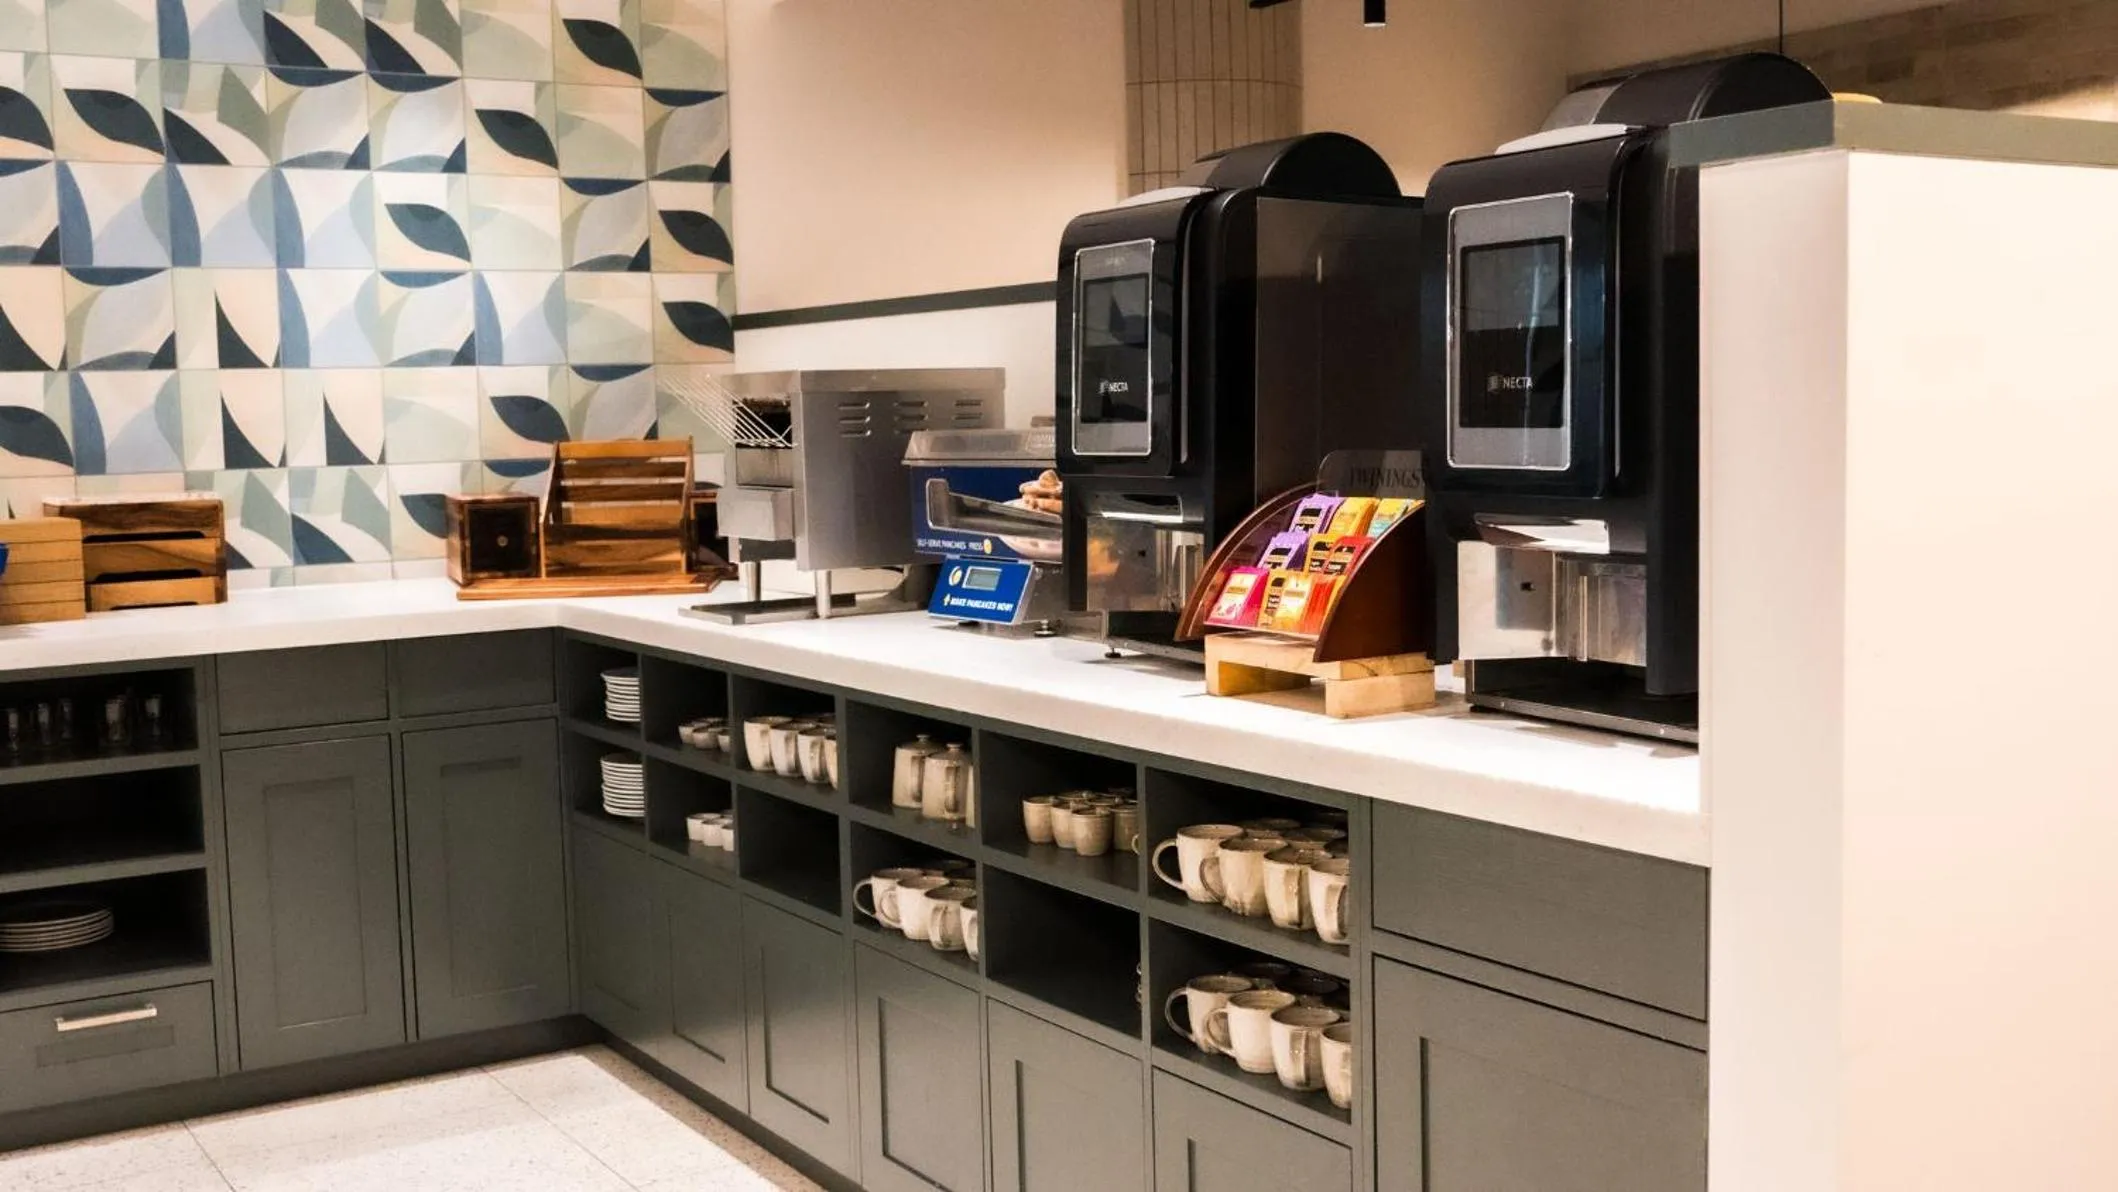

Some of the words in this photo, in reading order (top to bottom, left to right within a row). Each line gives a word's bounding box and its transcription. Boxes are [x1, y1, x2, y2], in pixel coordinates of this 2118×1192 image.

[1109, 381, 1128, 392] NECTA
[1503, 376, 1533, 389] NECTA
[1346, 467, 1420, 489] TWININGS
[967, 599, 996, 611] PANCAKES
